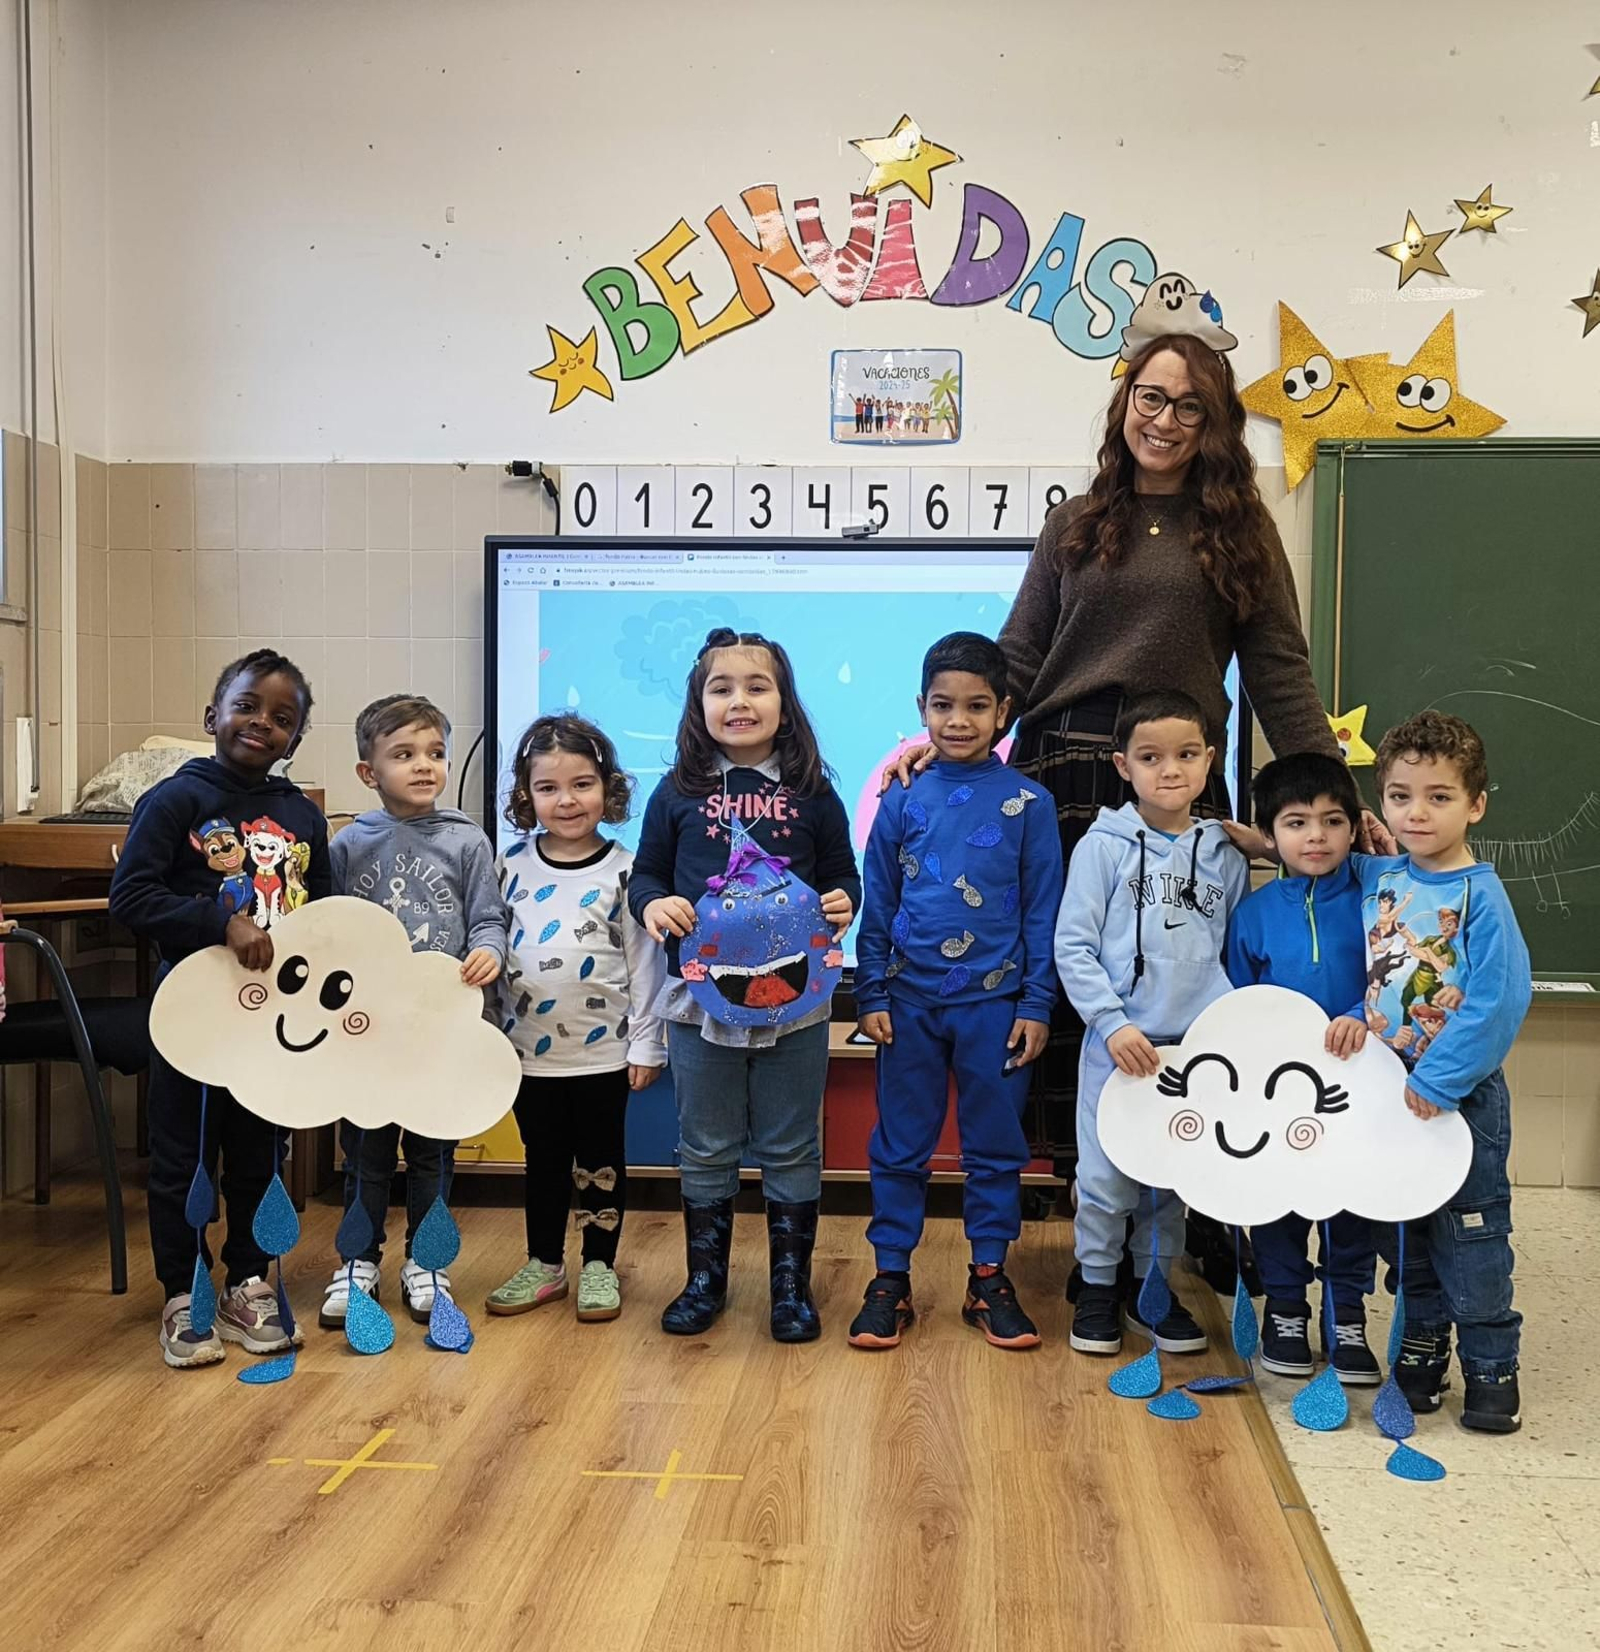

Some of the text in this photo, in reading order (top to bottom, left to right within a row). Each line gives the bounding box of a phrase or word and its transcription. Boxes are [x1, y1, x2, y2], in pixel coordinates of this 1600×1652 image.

[862, 366, 930, 381] VACACIONES
[879, 380, 911, 391] 2024-25
[574, 482, 597, 527] 0
[634, 483, 650, 528] 1
[691, 483, 713, 529] 2
[749, 483, 772, 529] 3
[808, 484, 831, 529] 4
[868, 484, 889, 530] 5
[926, 484, 949, 530] 6
[986, 484, 1008, 530] 7
[706, 793, 788, 821] SHINE
[352, 853, 454, 915] HOY SAILOR
[1128, 873, 1224, 918] NIKE
[413, 901, 430, 916] 89
